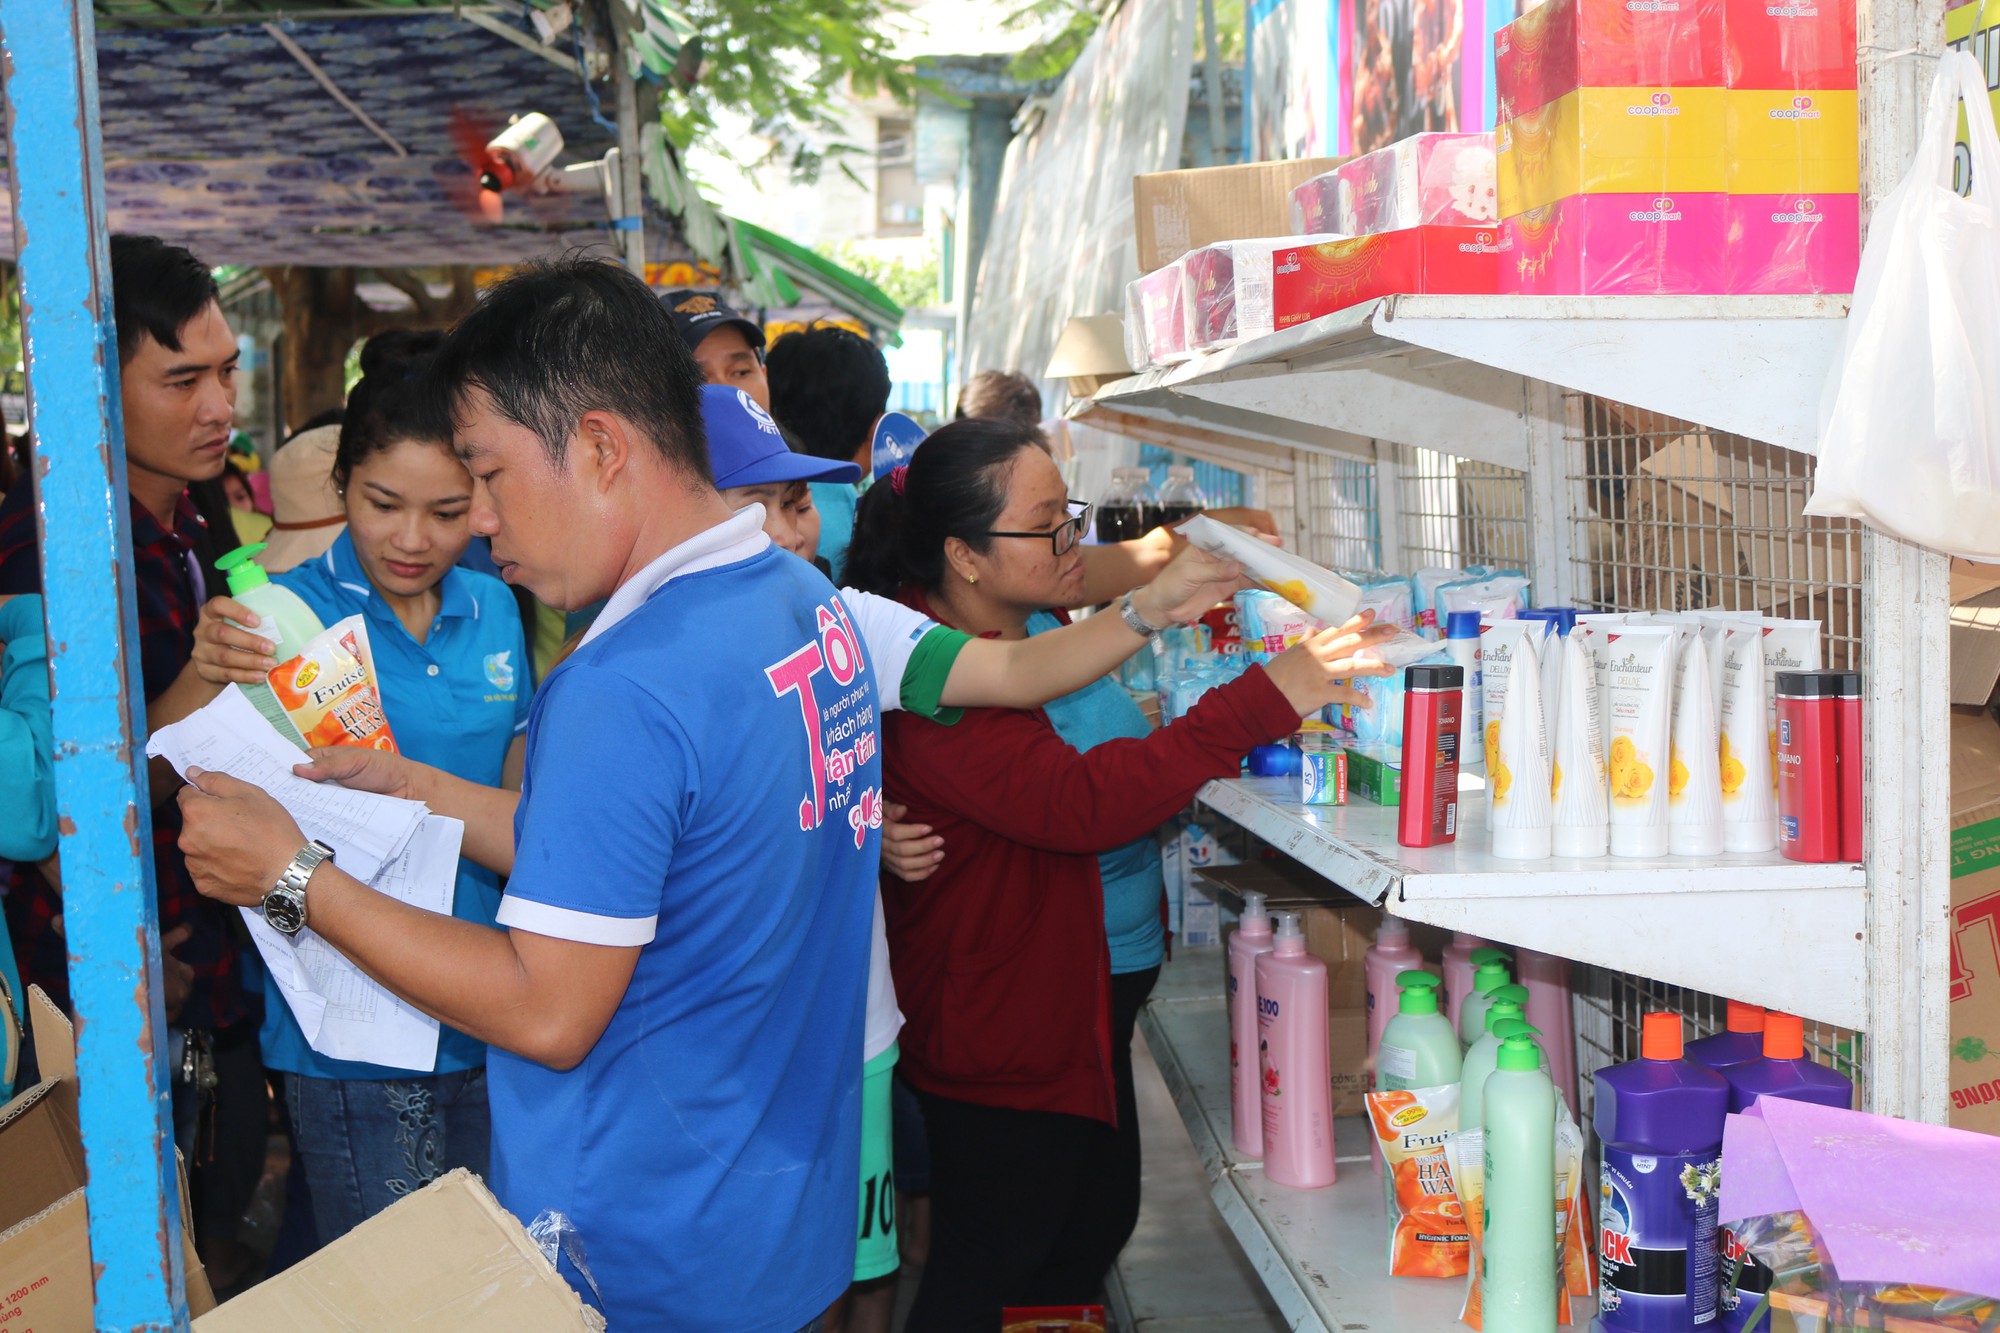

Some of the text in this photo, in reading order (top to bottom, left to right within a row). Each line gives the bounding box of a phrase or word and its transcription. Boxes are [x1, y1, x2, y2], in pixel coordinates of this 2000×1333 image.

[1418, 1164, 1450, 1180] HA
[1420, 1180, 1454, 1195] WA
[860, 1170, 893, 1239] 10
[5, 1286, 29, 1305] 1200
[30, 1276, 49, 1291] mm
